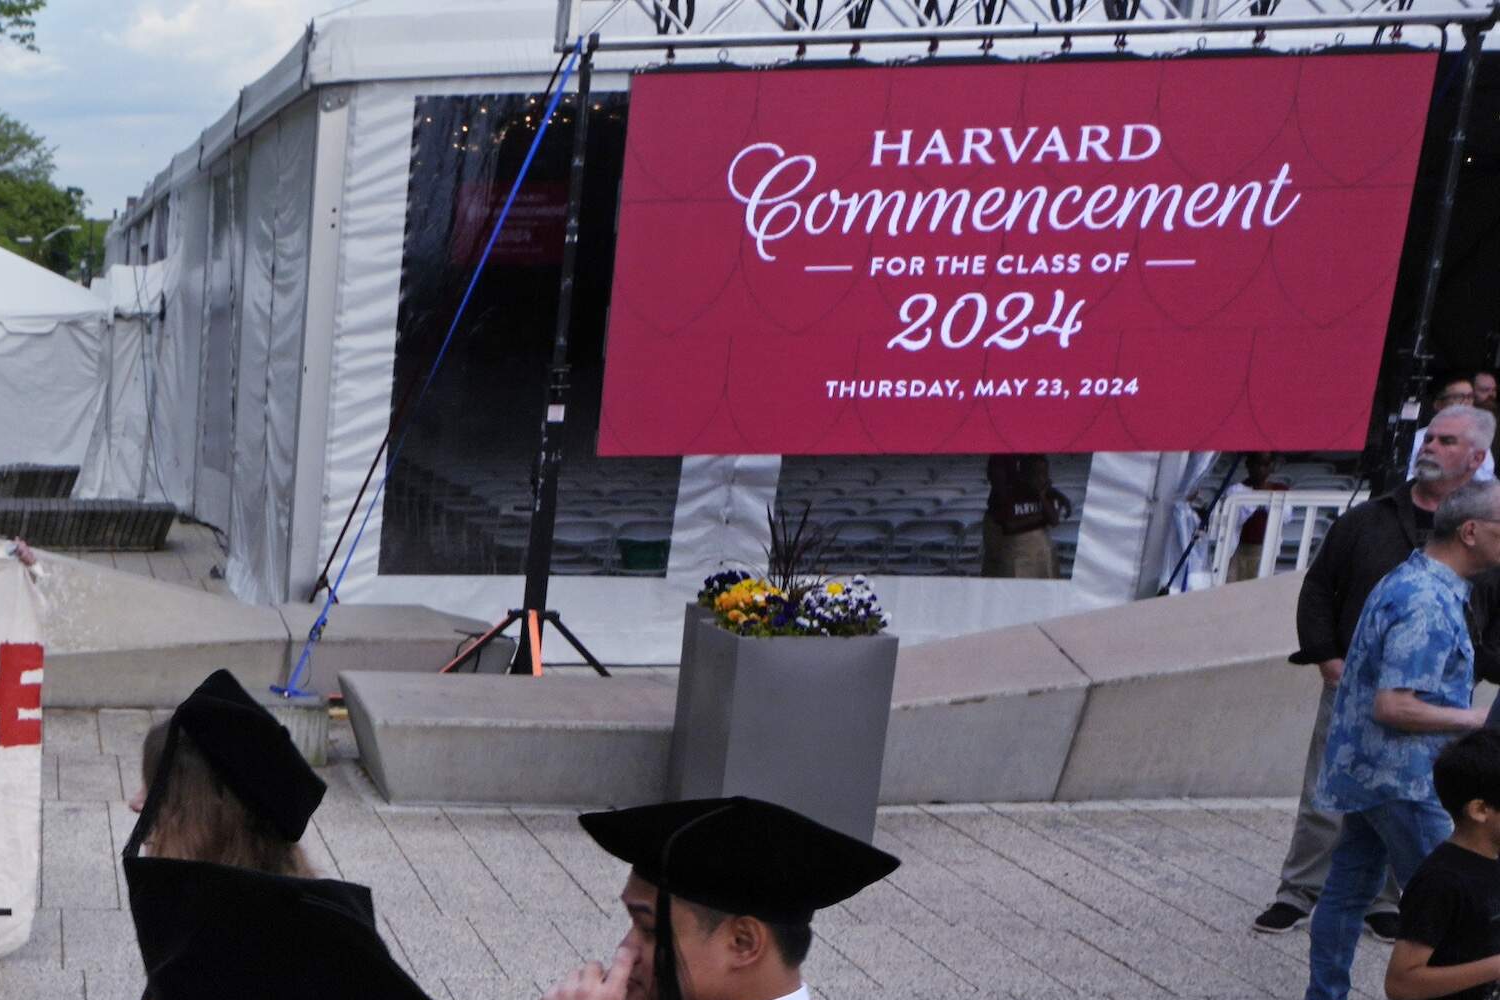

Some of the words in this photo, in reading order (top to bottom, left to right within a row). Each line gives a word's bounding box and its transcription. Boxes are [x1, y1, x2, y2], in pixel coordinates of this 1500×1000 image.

[870, 123, 1163, 167] HARVARD
[726, 141, 1302, 262] Commencement
[870, 255, 926, 276] FOR
[935, 254, 987, 275] THE
[996, 252, 1081, 274] CLASS
[1091, 252, 1130, 273] OF
[886, 288, 1086, 351] 2024
[826, 378, 965, 400] THURSDAY,
[973, 378, 1029, 397] MAY
[1035, 378, 1070, 399] 23,
[1079, 377, 1139, 397] 2024
